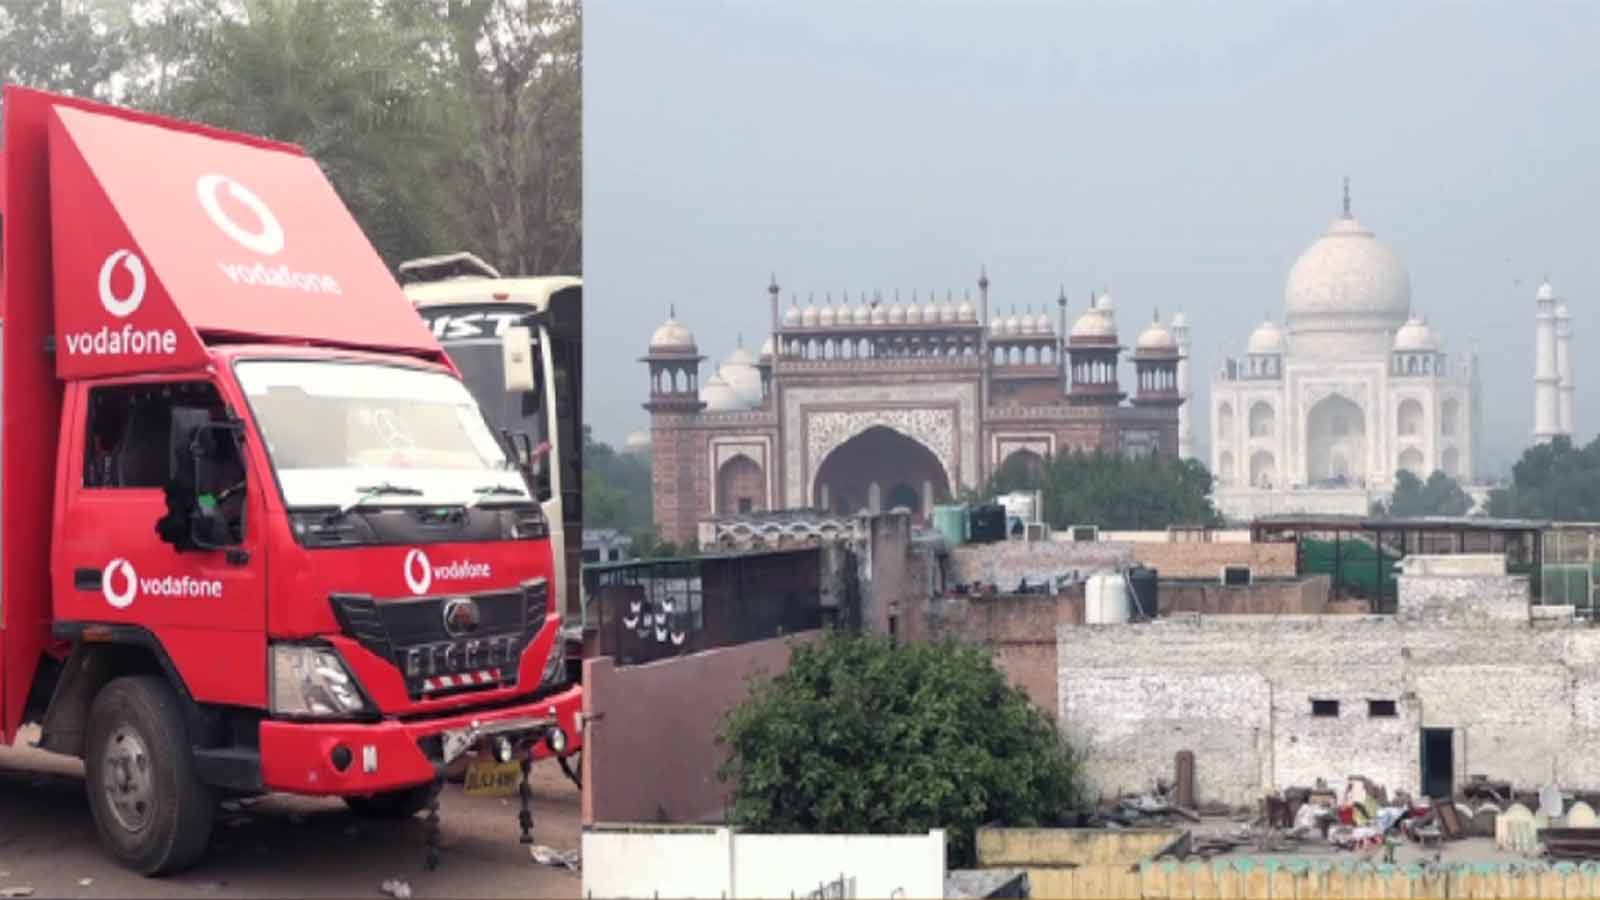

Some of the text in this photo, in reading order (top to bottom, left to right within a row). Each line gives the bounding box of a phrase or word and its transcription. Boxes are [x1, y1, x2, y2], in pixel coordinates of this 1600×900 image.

[217, 262, 341, 295] vodafone
[424, 313, 525, 337] IST
[65, 323, 177, 355] vodafone
[431, 559, 491, 580] vodafone
[140, 575, 223, 598] vodafone
